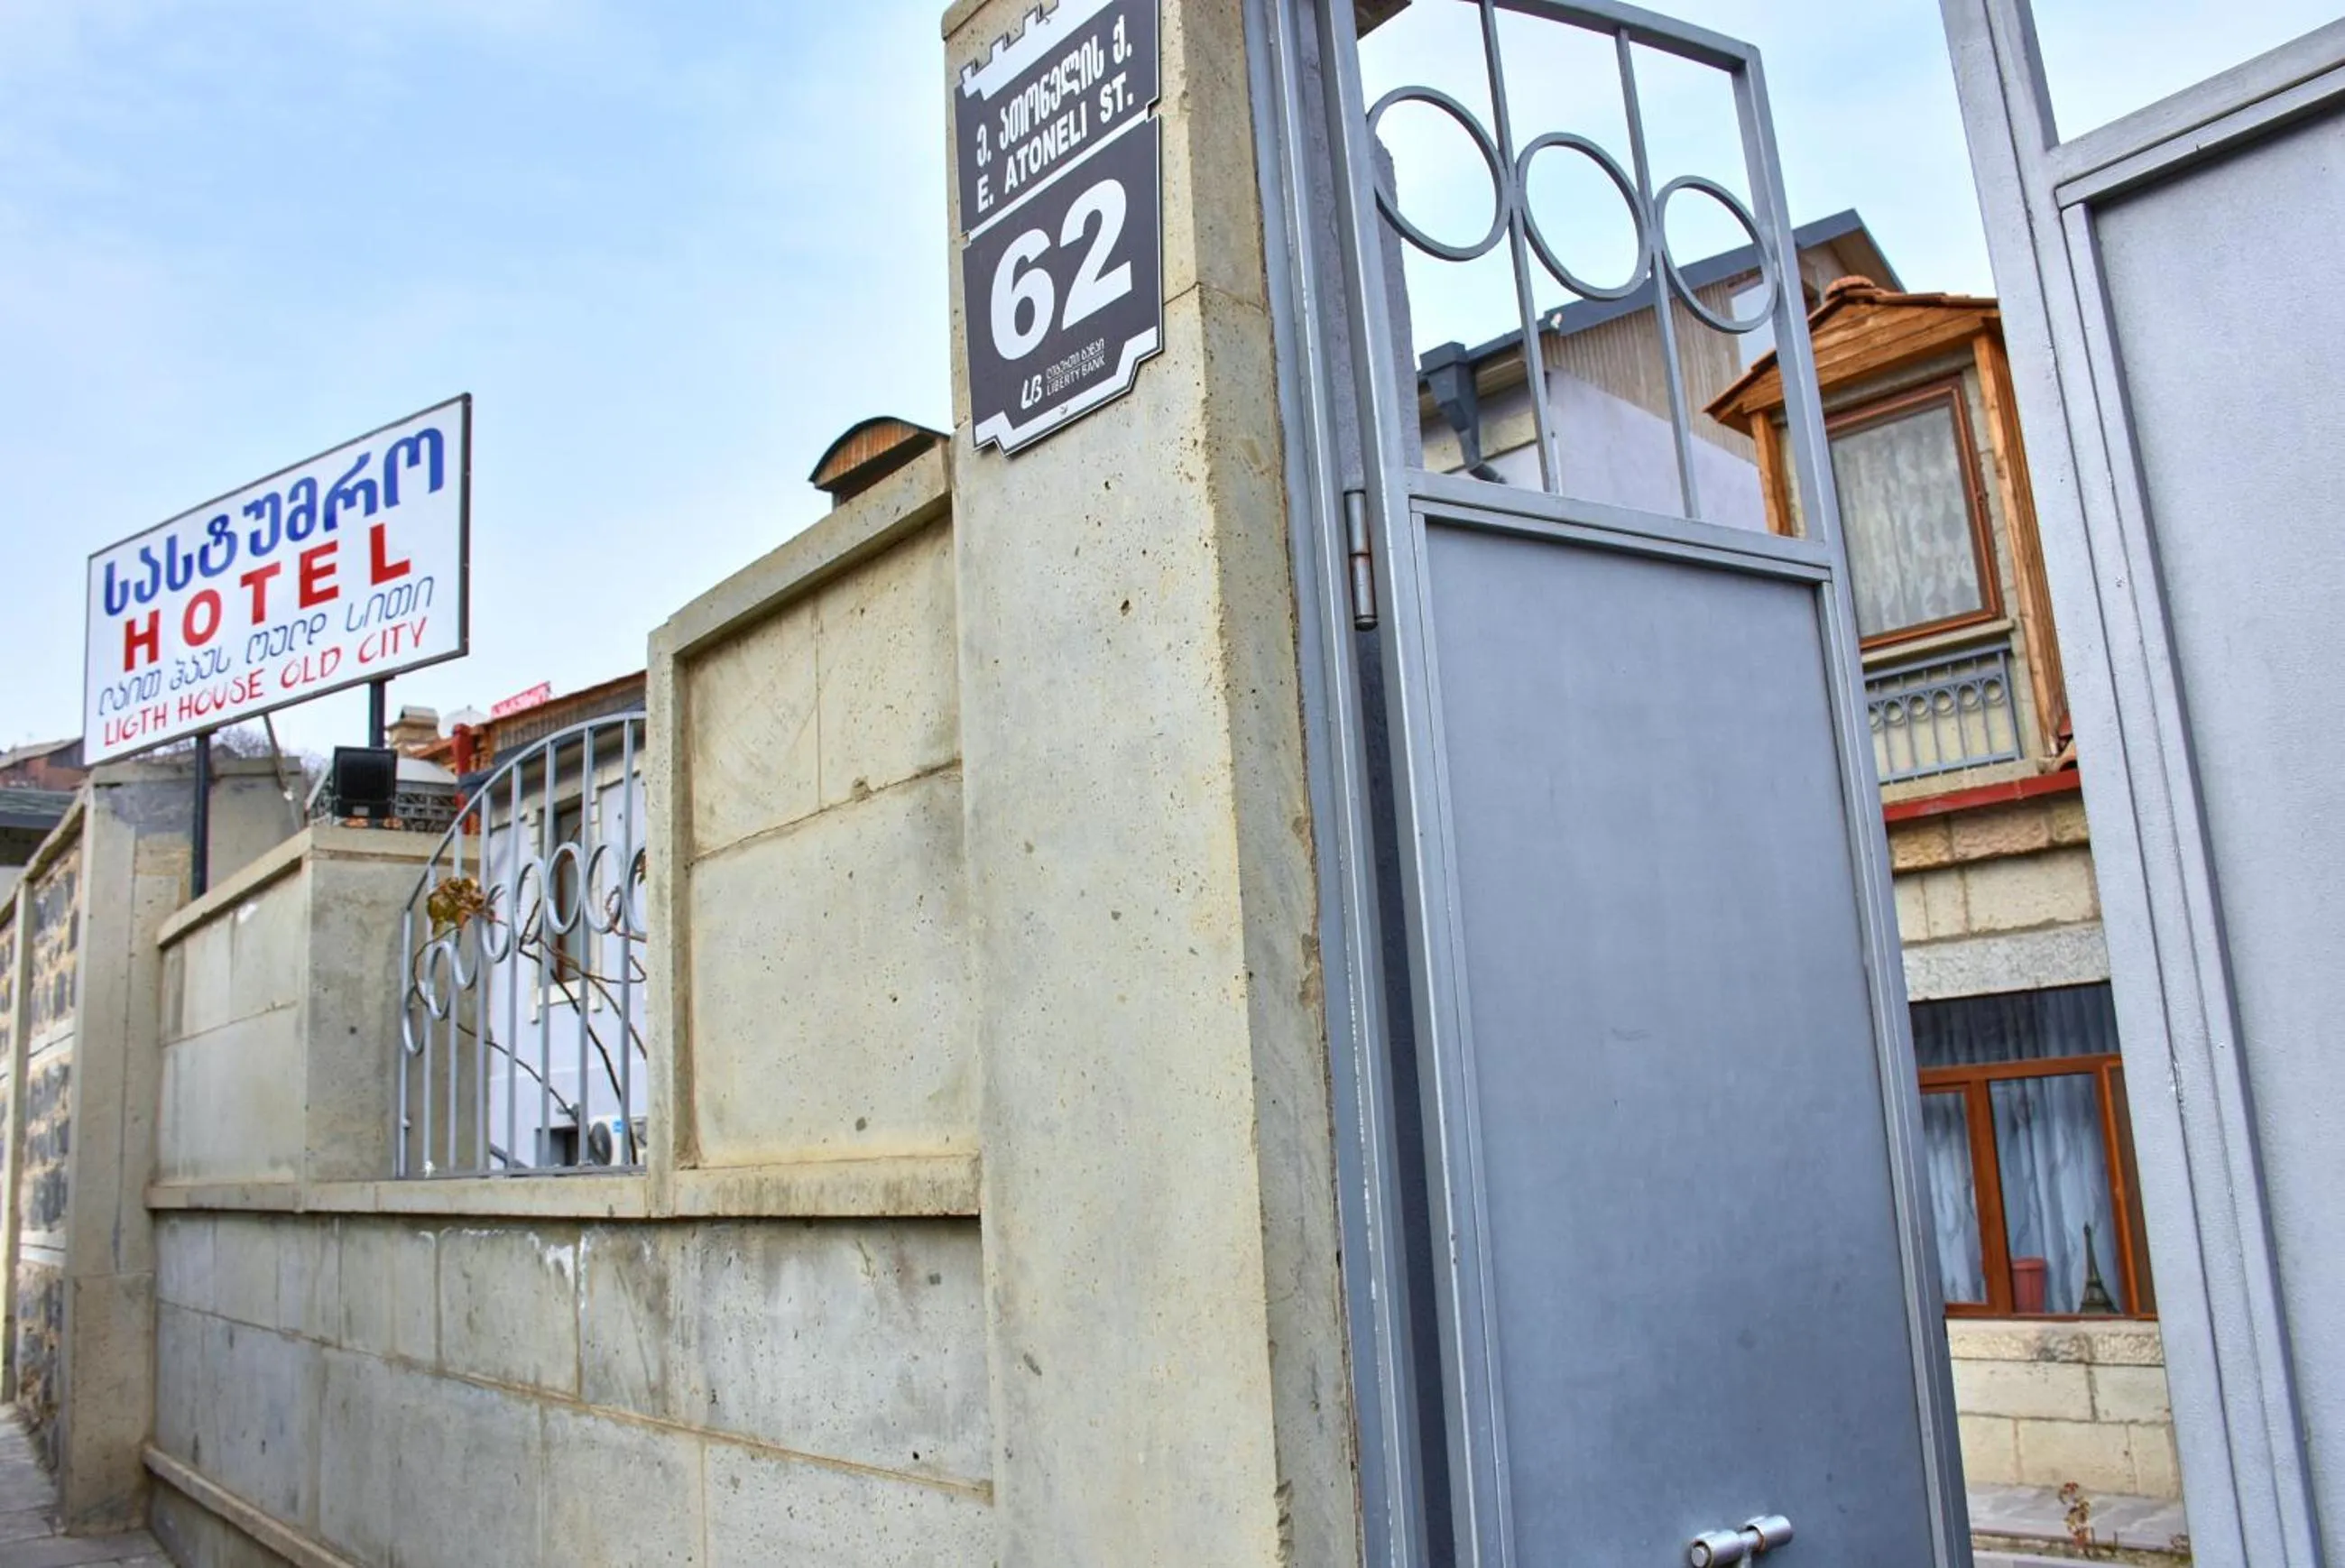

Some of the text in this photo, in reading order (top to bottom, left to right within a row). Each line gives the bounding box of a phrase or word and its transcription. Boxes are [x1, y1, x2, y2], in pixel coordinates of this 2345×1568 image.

[976, 14, 1132, 167] ე. ათონელის ქ.
[977, 71, 1134, 213] E. ATONELI ST.
[991, 179, 1133, 360] 62
[1047, 355, 1105, 396] LIBERTY BANK
[105, 428, 444, 617] სასტუმრო
[124, 522, 411, 673] HOTEL
[346, 576, 434, 632] სითი
[104, 616, 428, 747] LIGTH HOUSE OLD CITY
